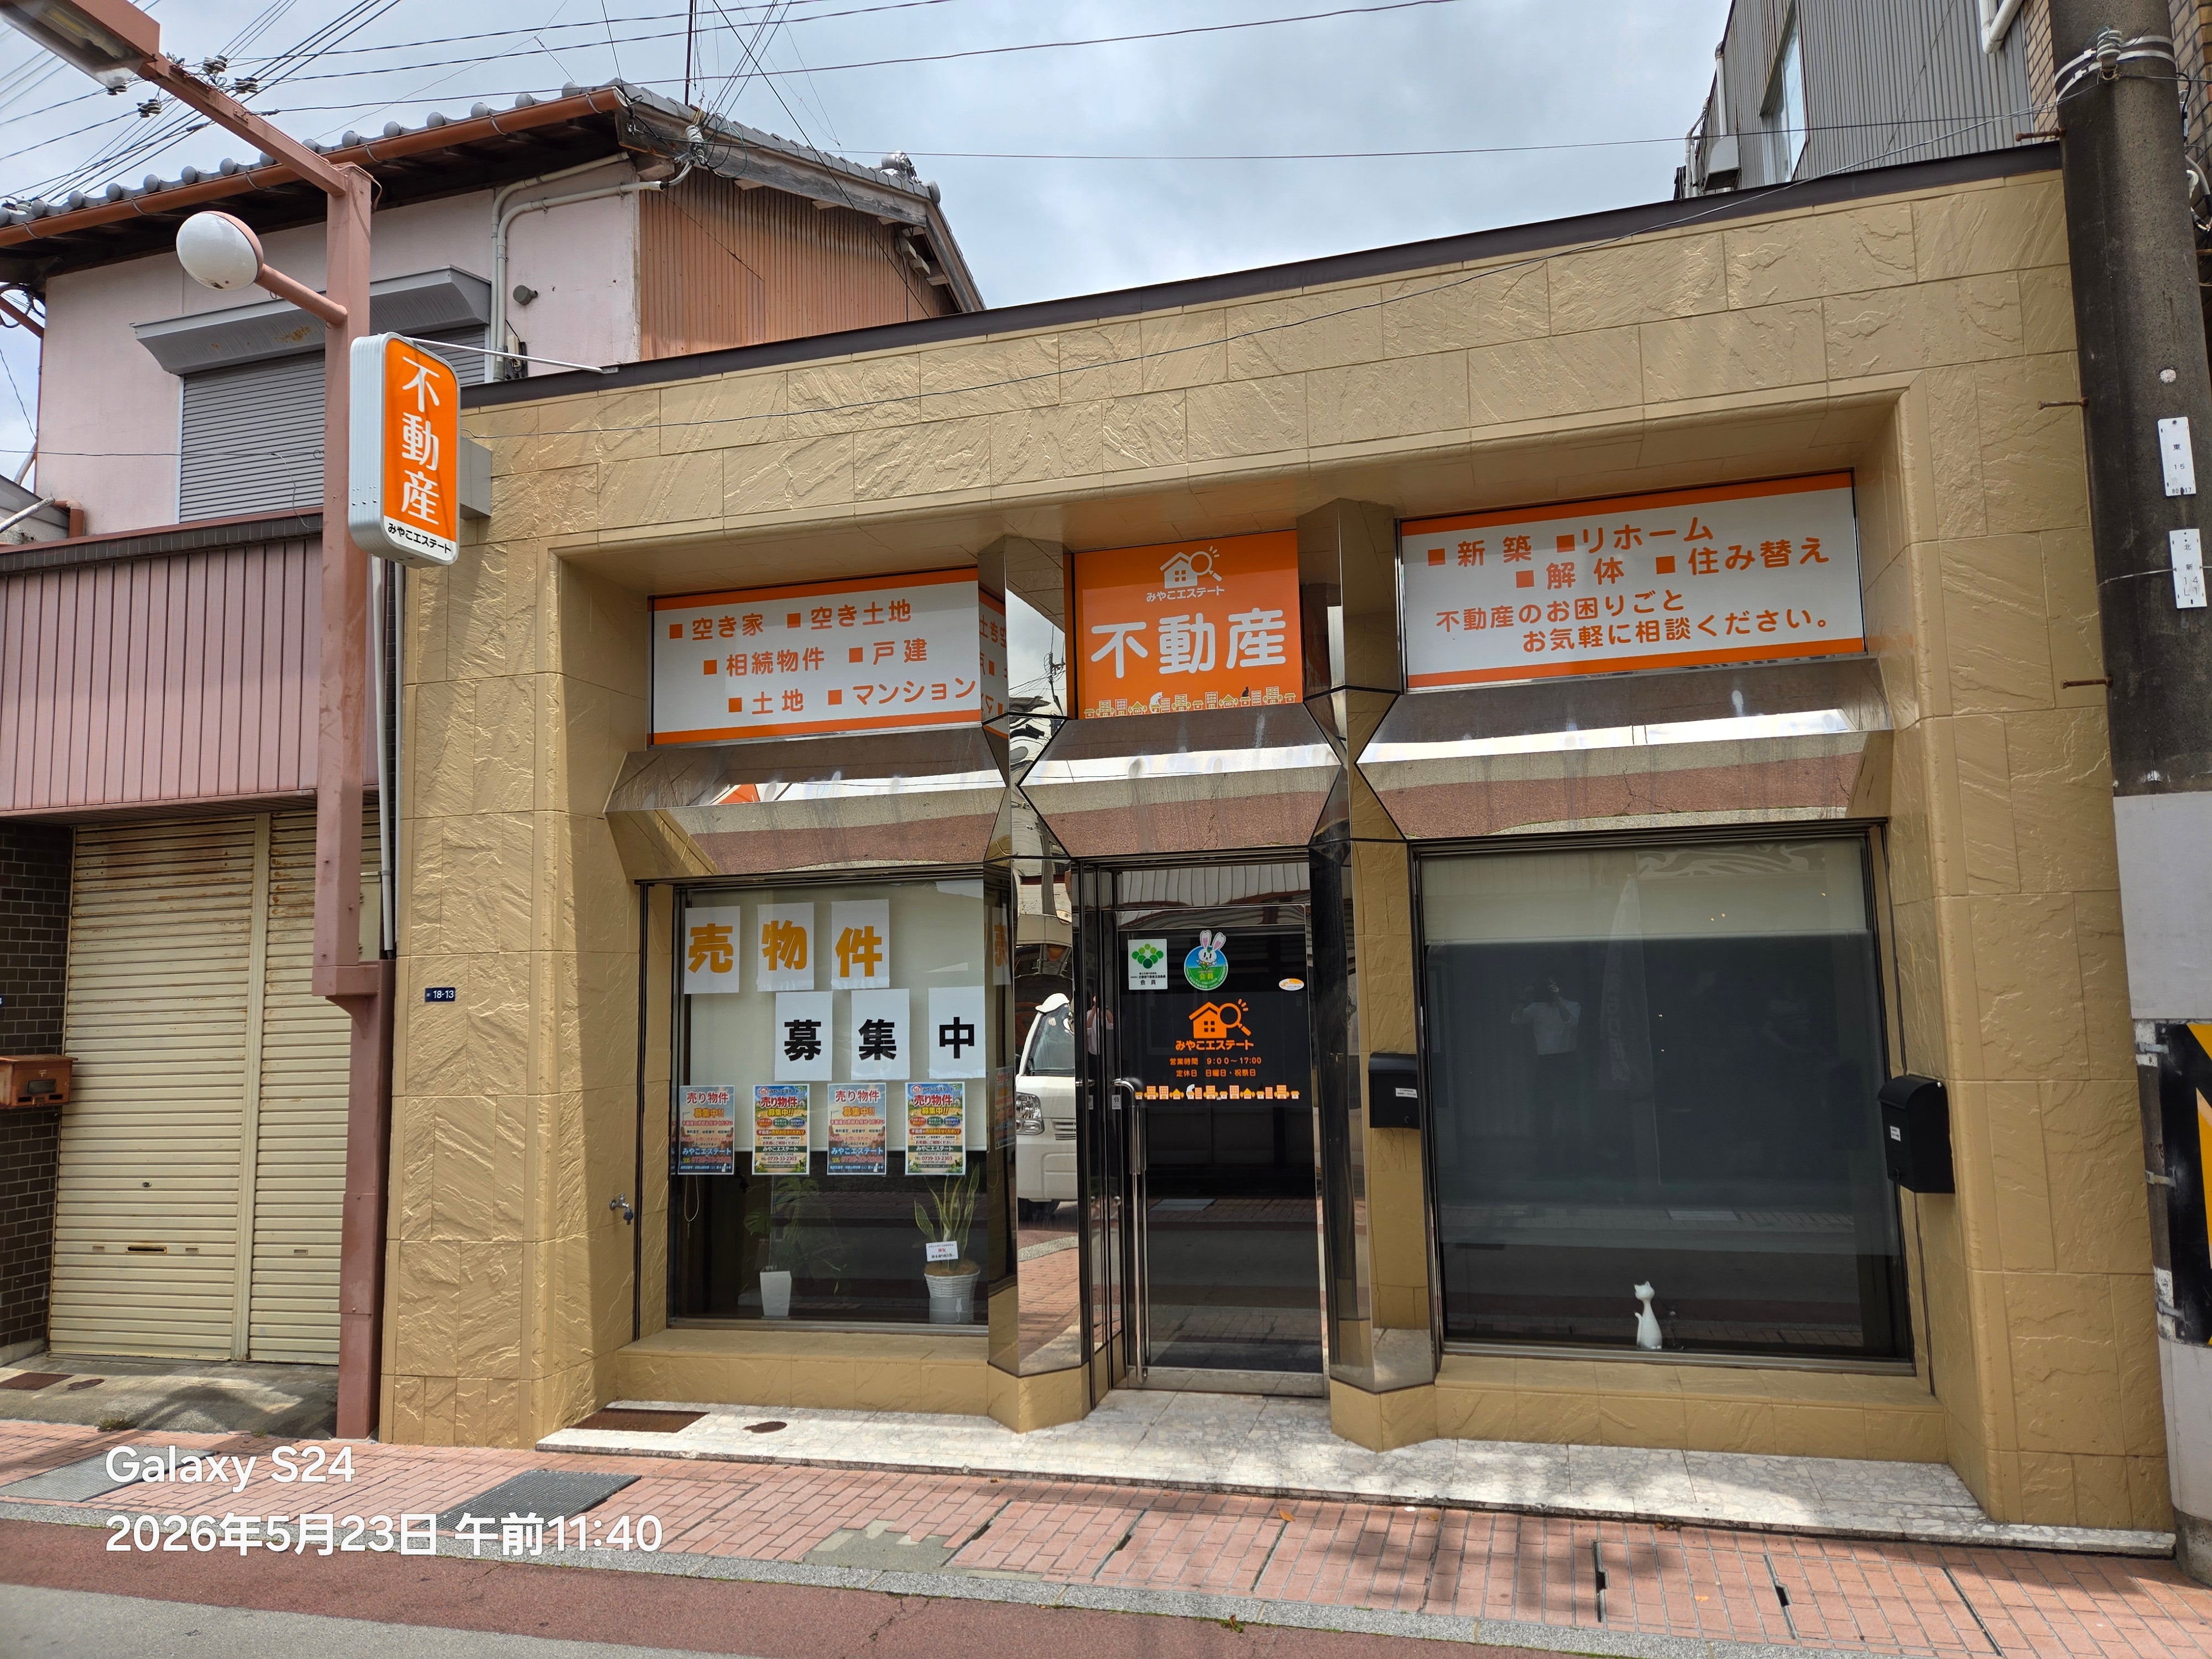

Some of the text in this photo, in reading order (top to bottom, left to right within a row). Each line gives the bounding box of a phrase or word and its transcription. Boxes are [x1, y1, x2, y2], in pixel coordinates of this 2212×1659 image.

[401, 356, 440, 525] 不動産
[388, 521, 452, 554] みやこエステート
[1457, 534, 1532, 568] 新築
[1582, 517, 1714, 554] リホーム
[1688, 535, 1830, 577] 住み替え
[1545, 557, 1625, 591] 解体
[1146, 585, 1225, 602] みやこエステート
[692, 598, 911, 641] 空き家 空き土地
[1436, 589, 1685, 634] 不動産のお困りごと
[1091, 607, 1286, 679] 不動産
[1522, 607, 1829, 655] お気軽に相談ください。
[726, 638, 927, 677] 相続物件 戸建
[752, 677, 976, 714] 土地 マンション
[433, 990, 454, 999] 18-13
[1170, 1057, 1198, 1066] 営業時間
[1175, 1039, 1254, 1051] みやこエステート
[687, 1092, 729, 1104] 売り物件
[761, 1097, 798, 1108] 売り物件
[835, 1090, 880, 1103] 売り物件
[914, 1094, 953, 1107] 売り物件
[682, 1147, 732, 1156] みやこエステート
